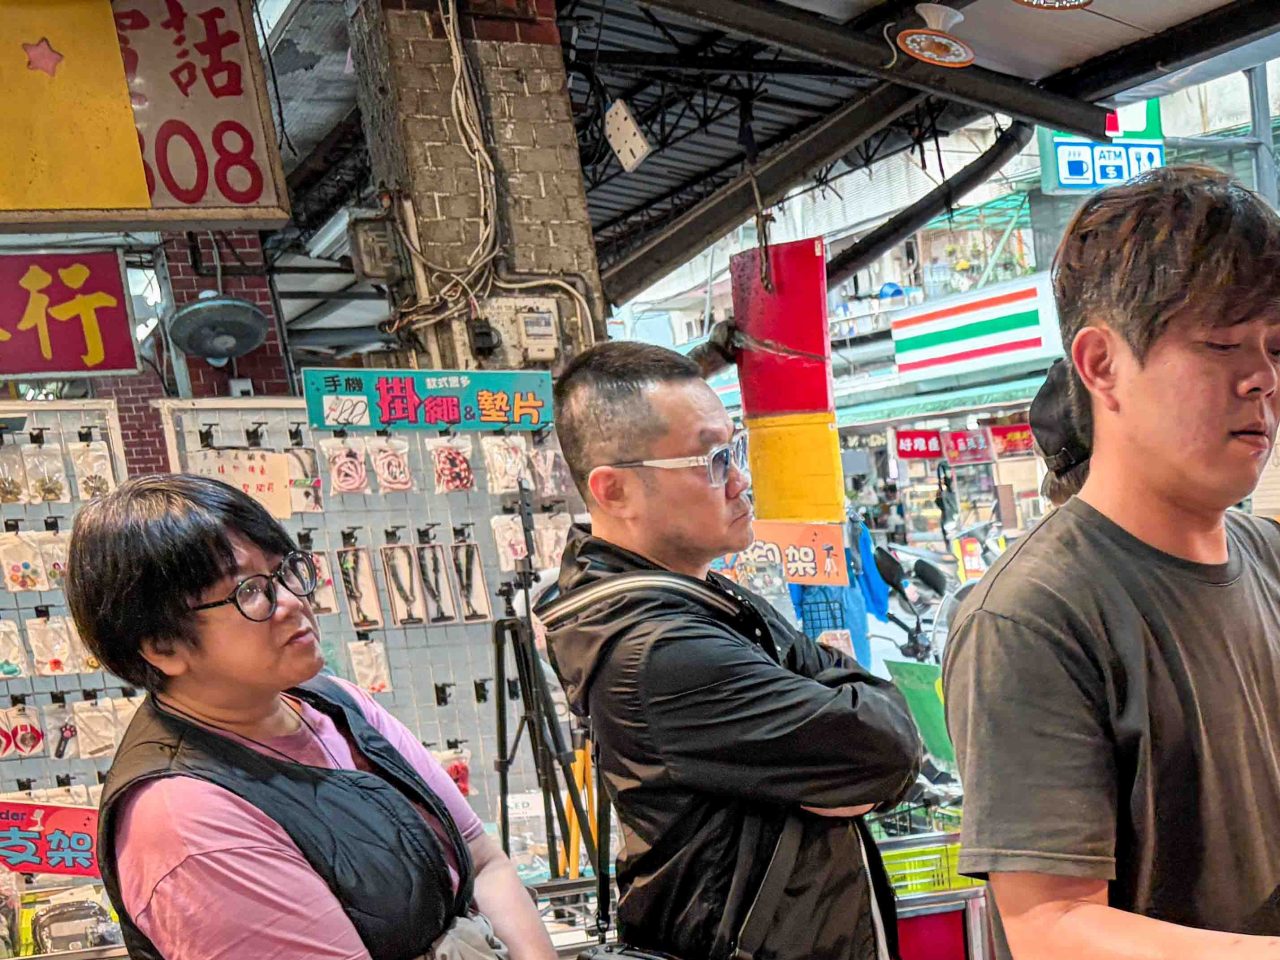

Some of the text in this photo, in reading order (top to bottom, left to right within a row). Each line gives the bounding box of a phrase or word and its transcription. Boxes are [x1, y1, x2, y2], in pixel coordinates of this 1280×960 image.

[136, 118, 264, 204] 08
[1099, 150, 1122, 161] ATM
[0, 264, 118, 368] 行
[324, 374, 364, 393] 手機
[374, 376, 545, 425] 掛繩 & 墊片
[0, 826, 94, 869] 支架
